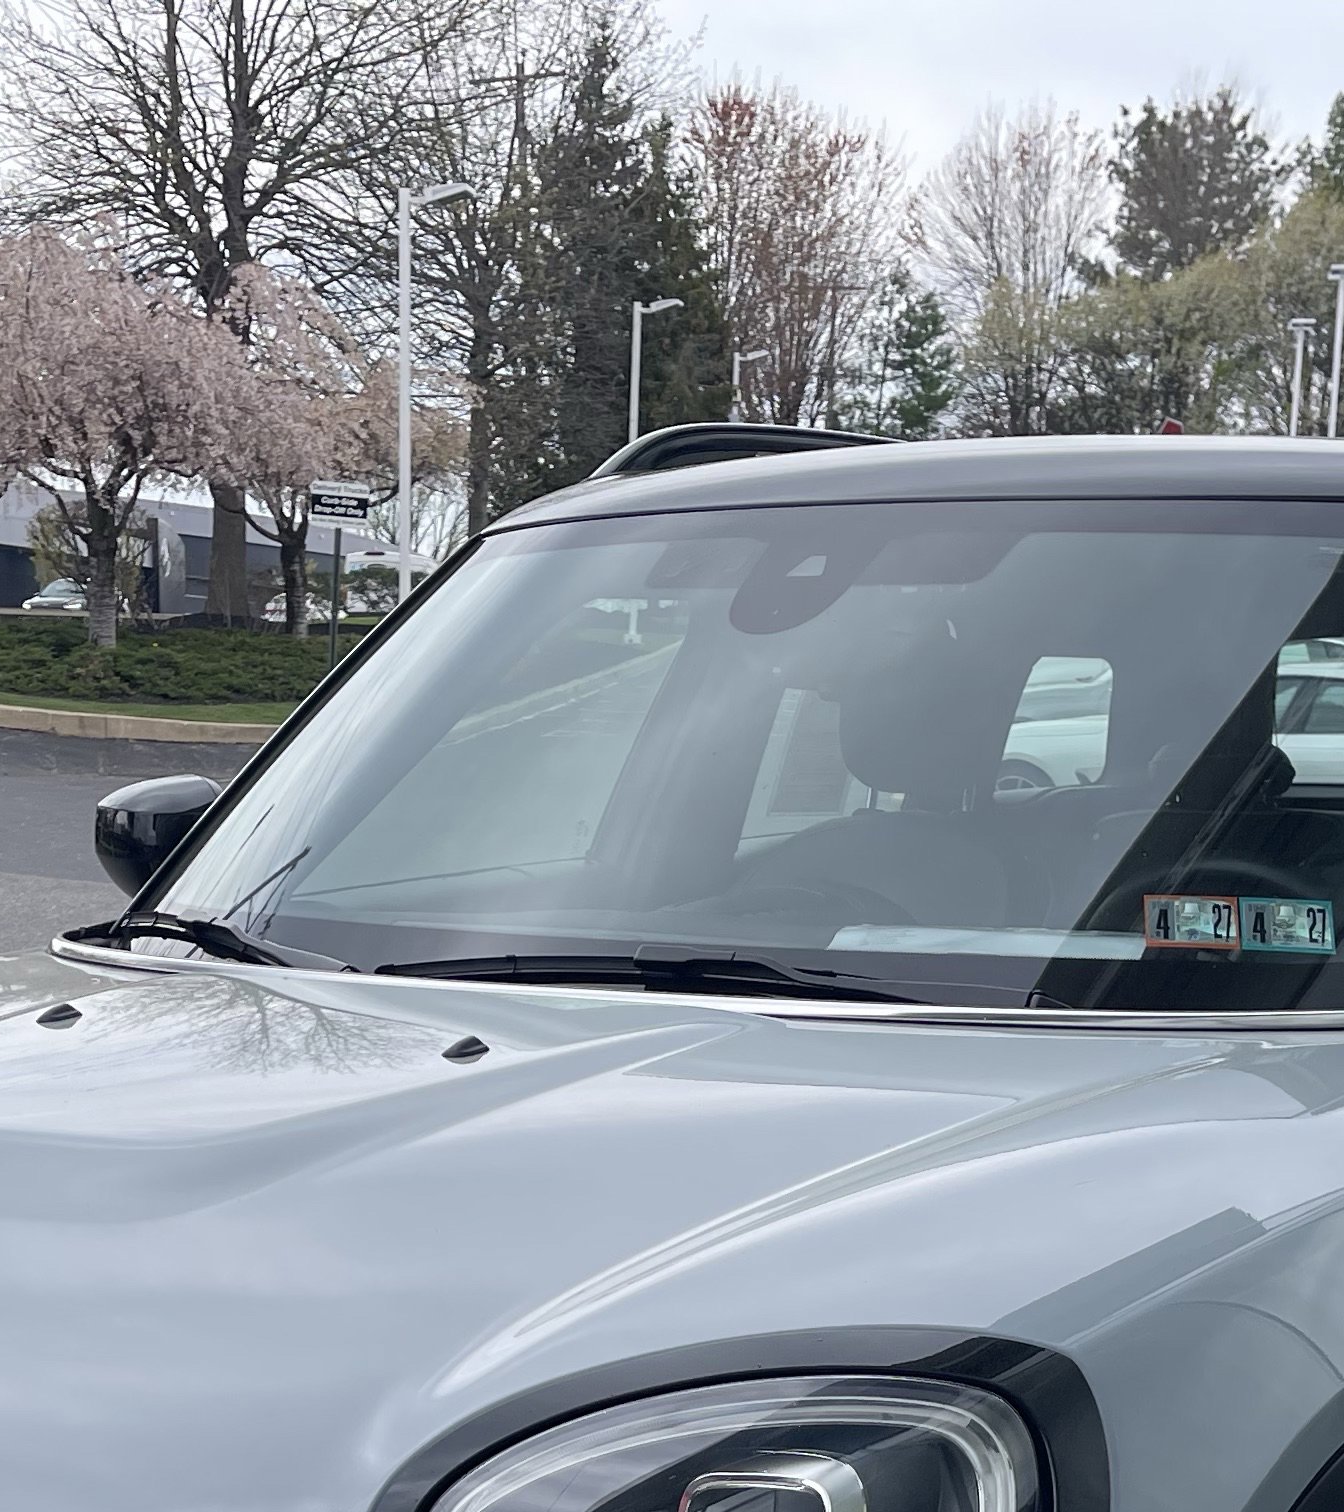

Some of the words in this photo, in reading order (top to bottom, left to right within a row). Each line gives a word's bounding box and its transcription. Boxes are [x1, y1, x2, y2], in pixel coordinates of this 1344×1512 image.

[1157, 909, 1170, 939] 4
[1212, 904, 1232, 941] 27
[1253, 912, 1266, 943] 4
[1307, 907, 1326, 945] 27
